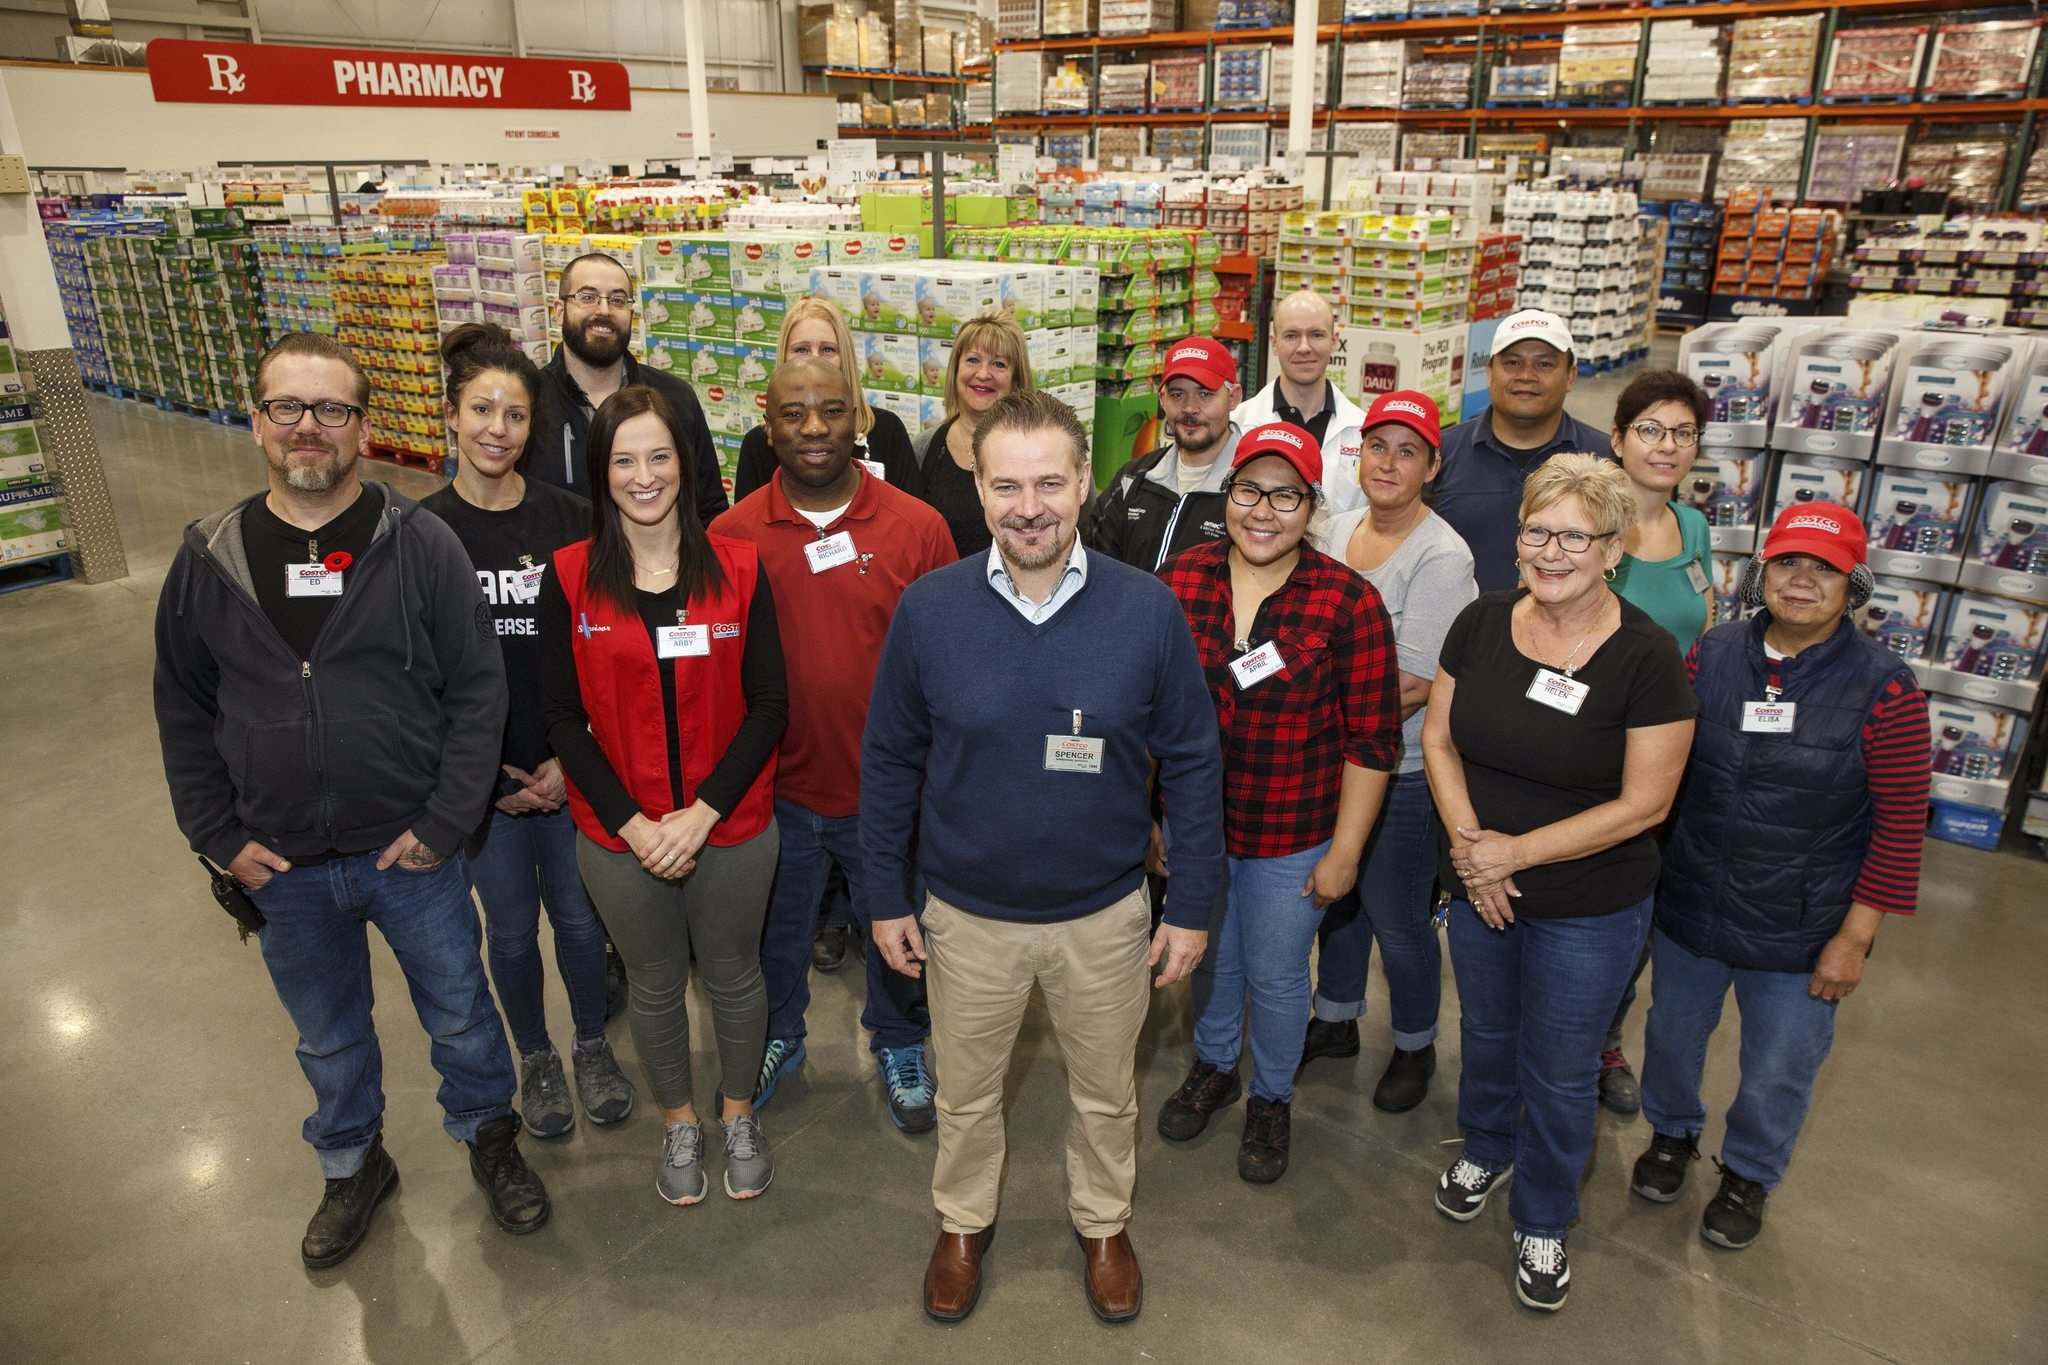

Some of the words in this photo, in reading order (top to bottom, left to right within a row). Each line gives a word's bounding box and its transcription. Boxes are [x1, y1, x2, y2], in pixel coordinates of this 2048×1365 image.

[333, 60, 504, 98] PHARMACY
[852, 169, 878, 183] 21.99
[1422, 355, 1449, 373] Program
[1364, 376, 1395, 390] DAILY
[1789, 515, 1840, 530] COSTCO
[818, 546, 848, 561] RICHARD
[309, 578, 321, 586] ED
[673, 639, 694, 647] ABBY
[1241, 651, 1266, 668] COSTCO
[1249, 661, 1268, 674] APRIL
[1547, 677, 1574, 692] COSTCO
[1544, 687, 1568, 699] HELEN
[1755, 706, 1784, 714] COSTCO
[1758, 715, 1780, 723] ELISA
[1055, 750, 1094, 760] SPENCER
